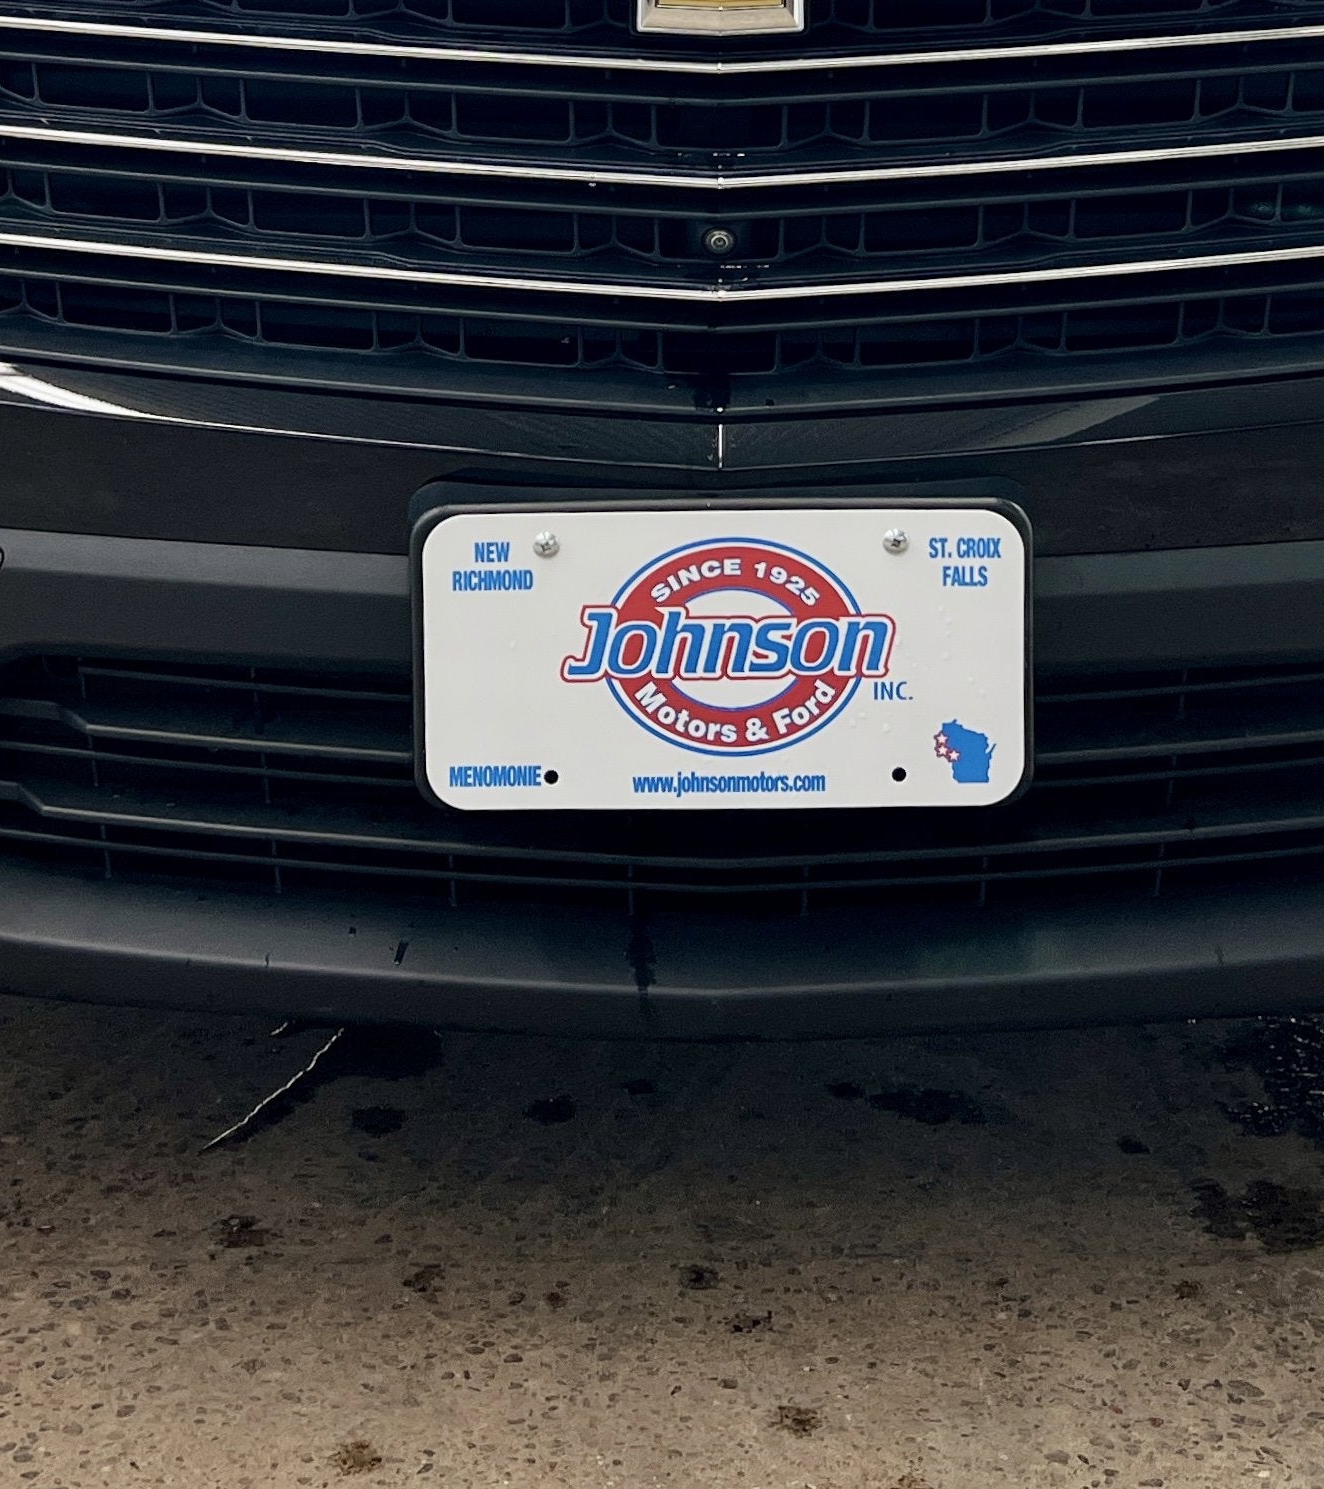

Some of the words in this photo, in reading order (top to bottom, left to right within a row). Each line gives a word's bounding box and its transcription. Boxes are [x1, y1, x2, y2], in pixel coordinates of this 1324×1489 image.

[474, 542, 510, 563] NEW
[928, 538, 952, 559] ST.
[956, 537, 1001, 559] CROIX
[452, 569, 534, 592] RICHMOND
[650, 558, 742, 603] SINCE
[754, 561, 821, 607] 1925
[942, 566, 988, 587] FALLS
[565, 608, 891, 678] Johnson
[873, 682, 914, 701] INC.
[633, 681, 738, 743] Motors
[744, 717, 769, 742] &
[772, 679, 837, 735] Ford
[449, 765, 541, 788] MENOMONIE
[632, 771, 826, 798] www.johnsonmotors.com
